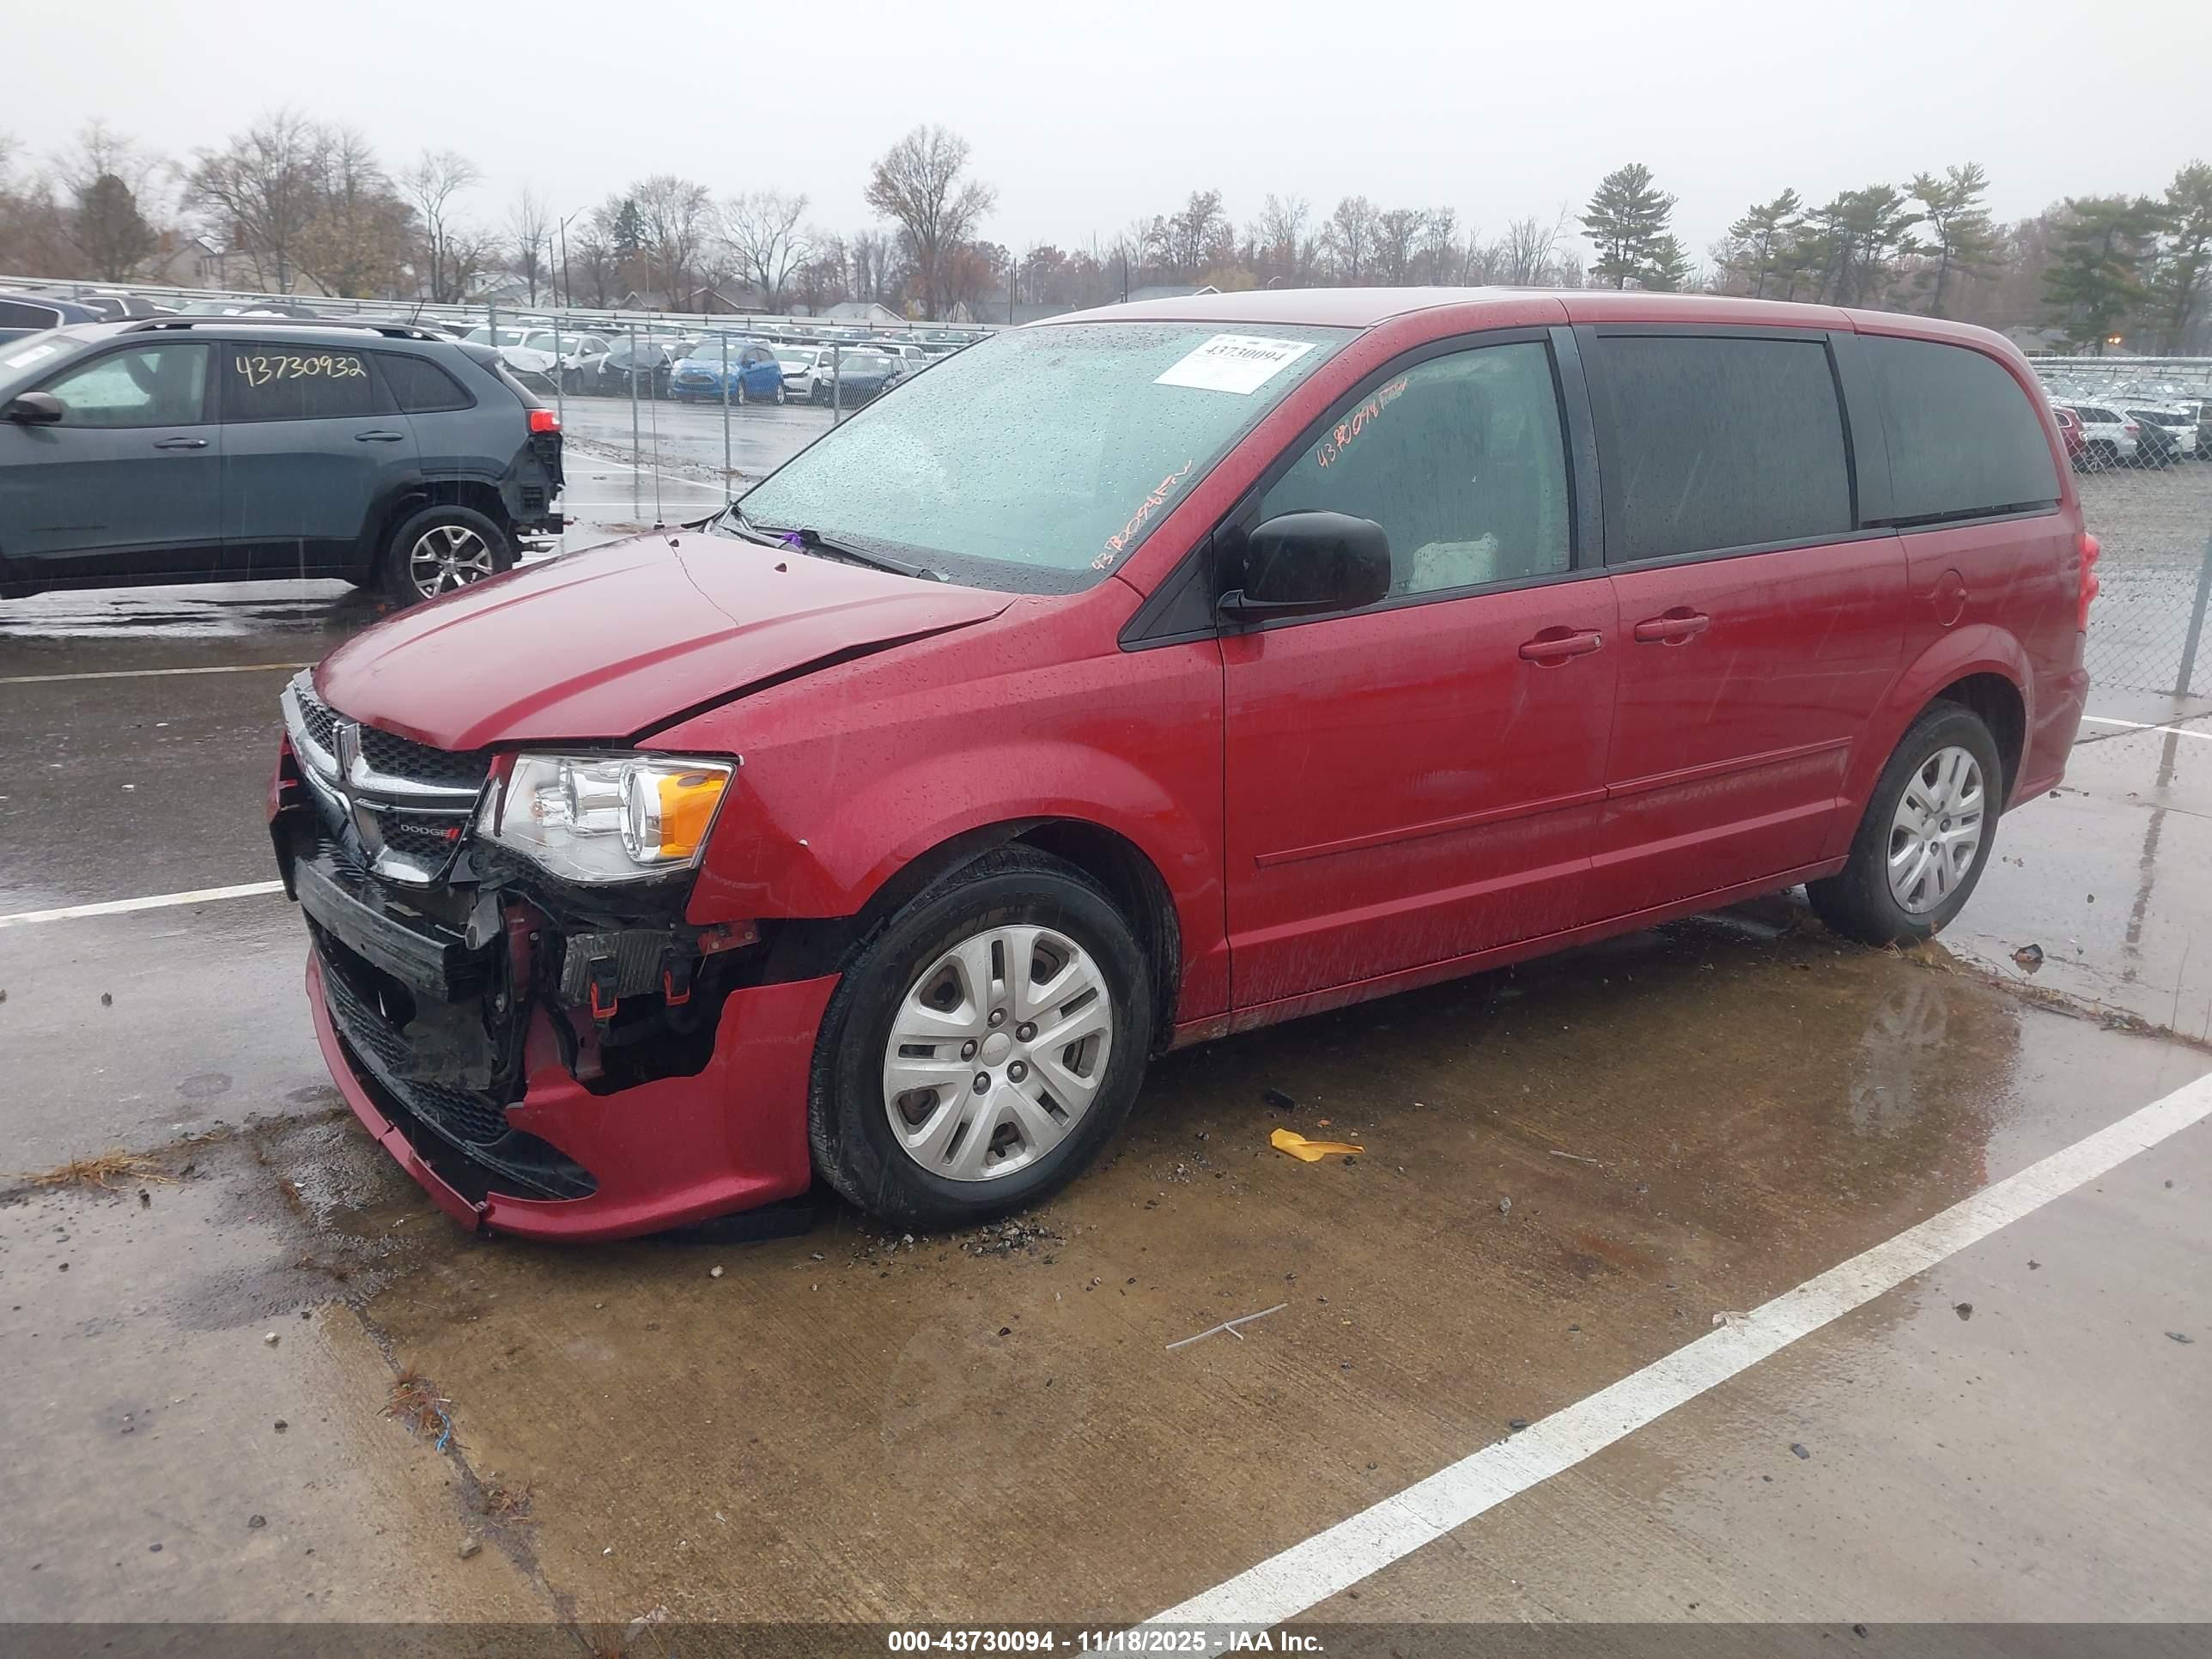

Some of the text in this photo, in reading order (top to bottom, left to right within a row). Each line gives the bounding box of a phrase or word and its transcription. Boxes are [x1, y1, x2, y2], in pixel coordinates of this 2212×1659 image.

[1205, 345, 1287, 362] 43730094
[236, 356, 367, 387] 43730932
[400, 824, 451, 837] DODGE
